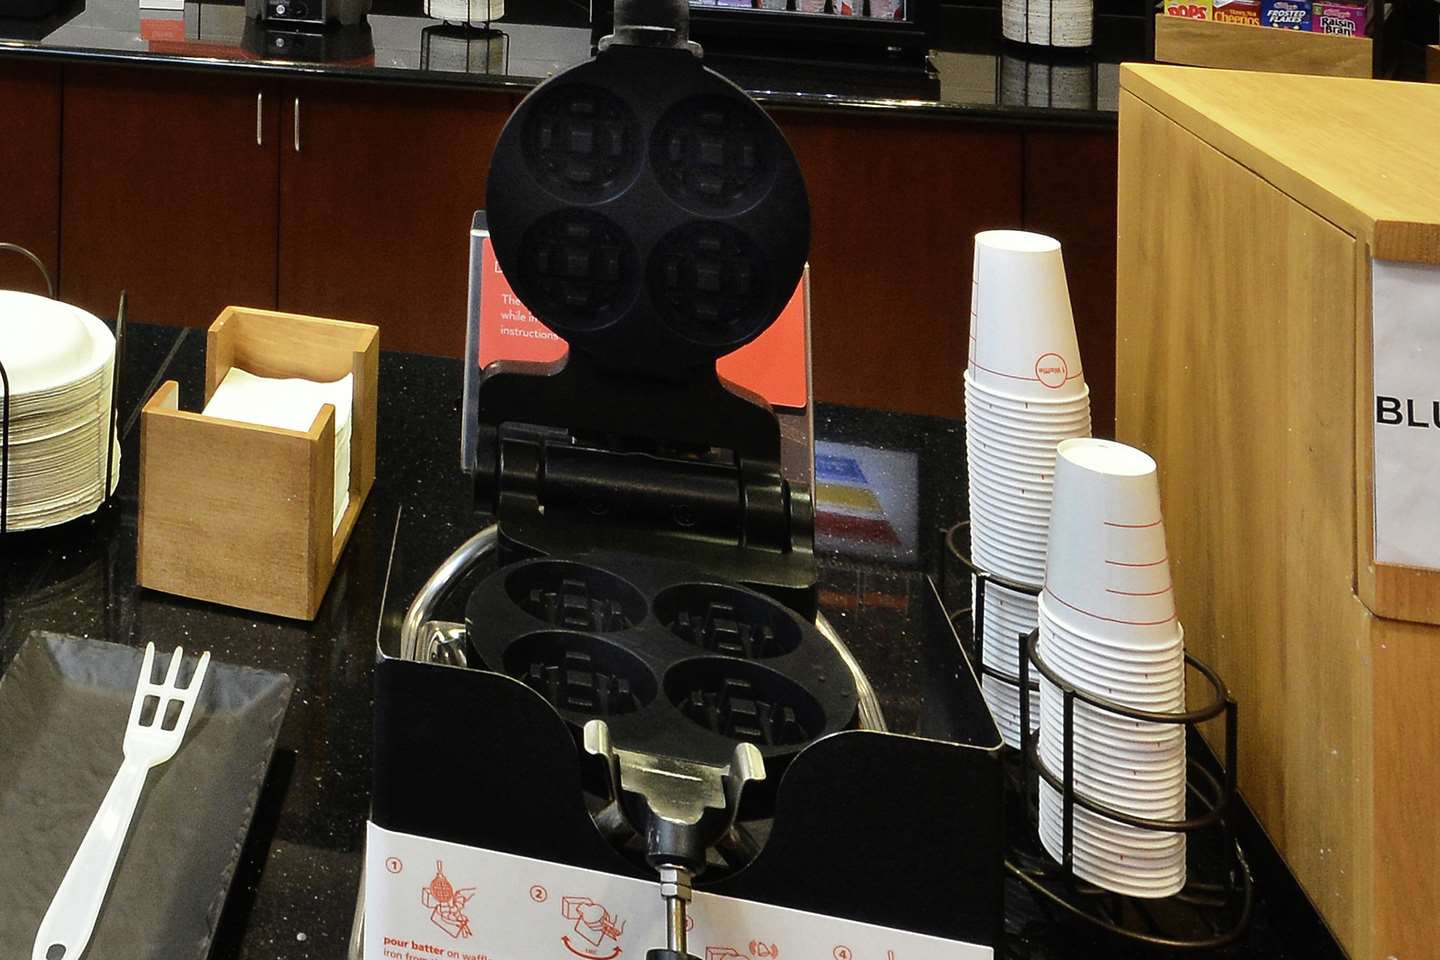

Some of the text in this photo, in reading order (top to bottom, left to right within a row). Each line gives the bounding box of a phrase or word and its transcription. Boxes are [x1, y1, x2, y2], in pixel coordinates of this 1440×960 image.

[1214, 11, 1260, 27] Cheerios
[1321, 17, 1355, 30] Raisin
[1325, 25, 1352, 37] Bran
[501, 309, 526, 322] while
[500, 325, 559, 341] instructions
[534, 889, 543, 899] 2
[383, 936, 492, 960] pour batter on waffl
[383, 949, 403, 960] iron
